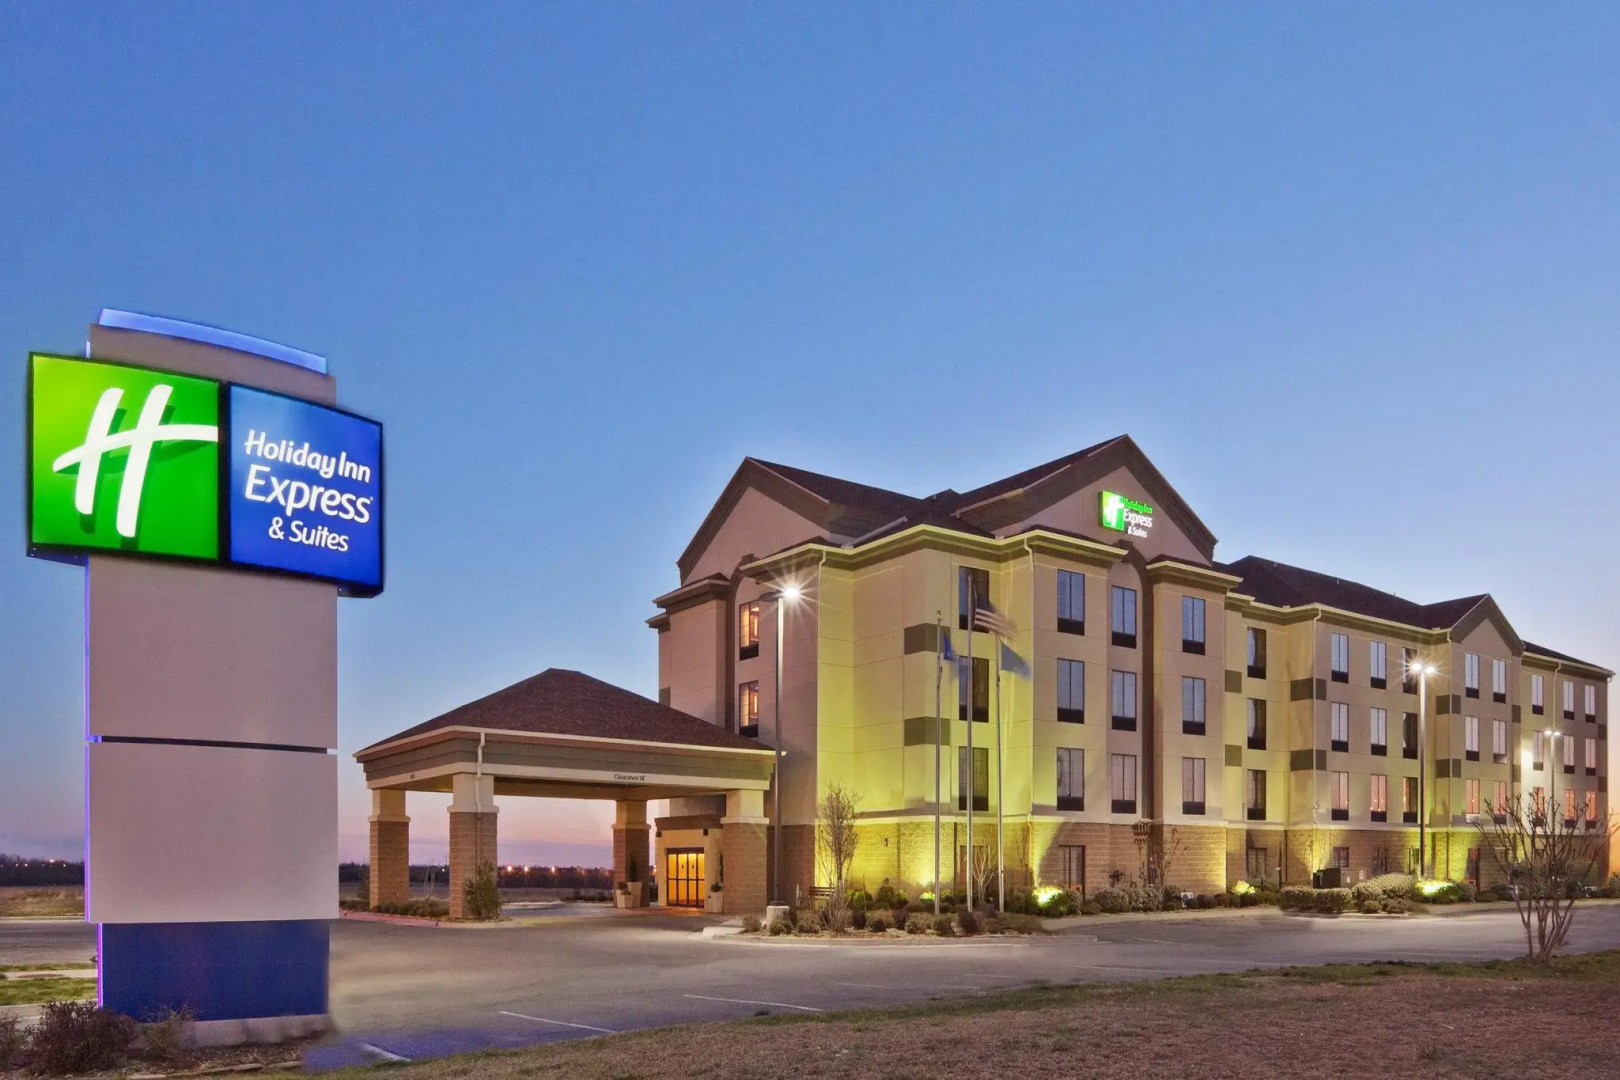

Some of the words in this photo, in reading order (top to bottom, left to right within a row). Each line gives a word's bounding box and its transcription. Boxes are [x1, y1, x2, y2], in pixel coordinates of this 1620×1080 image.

[244, 429, 336, 479] Holiday
[338, 451, 371, 484] Inn
[244, 464, 371, 524] Express
[268, 516, 285, 541] &
[288, 520, 349, 552] Suites
[1124, 508, 1152, 528] Express
[1133, 526, 1147, 538] Suites
